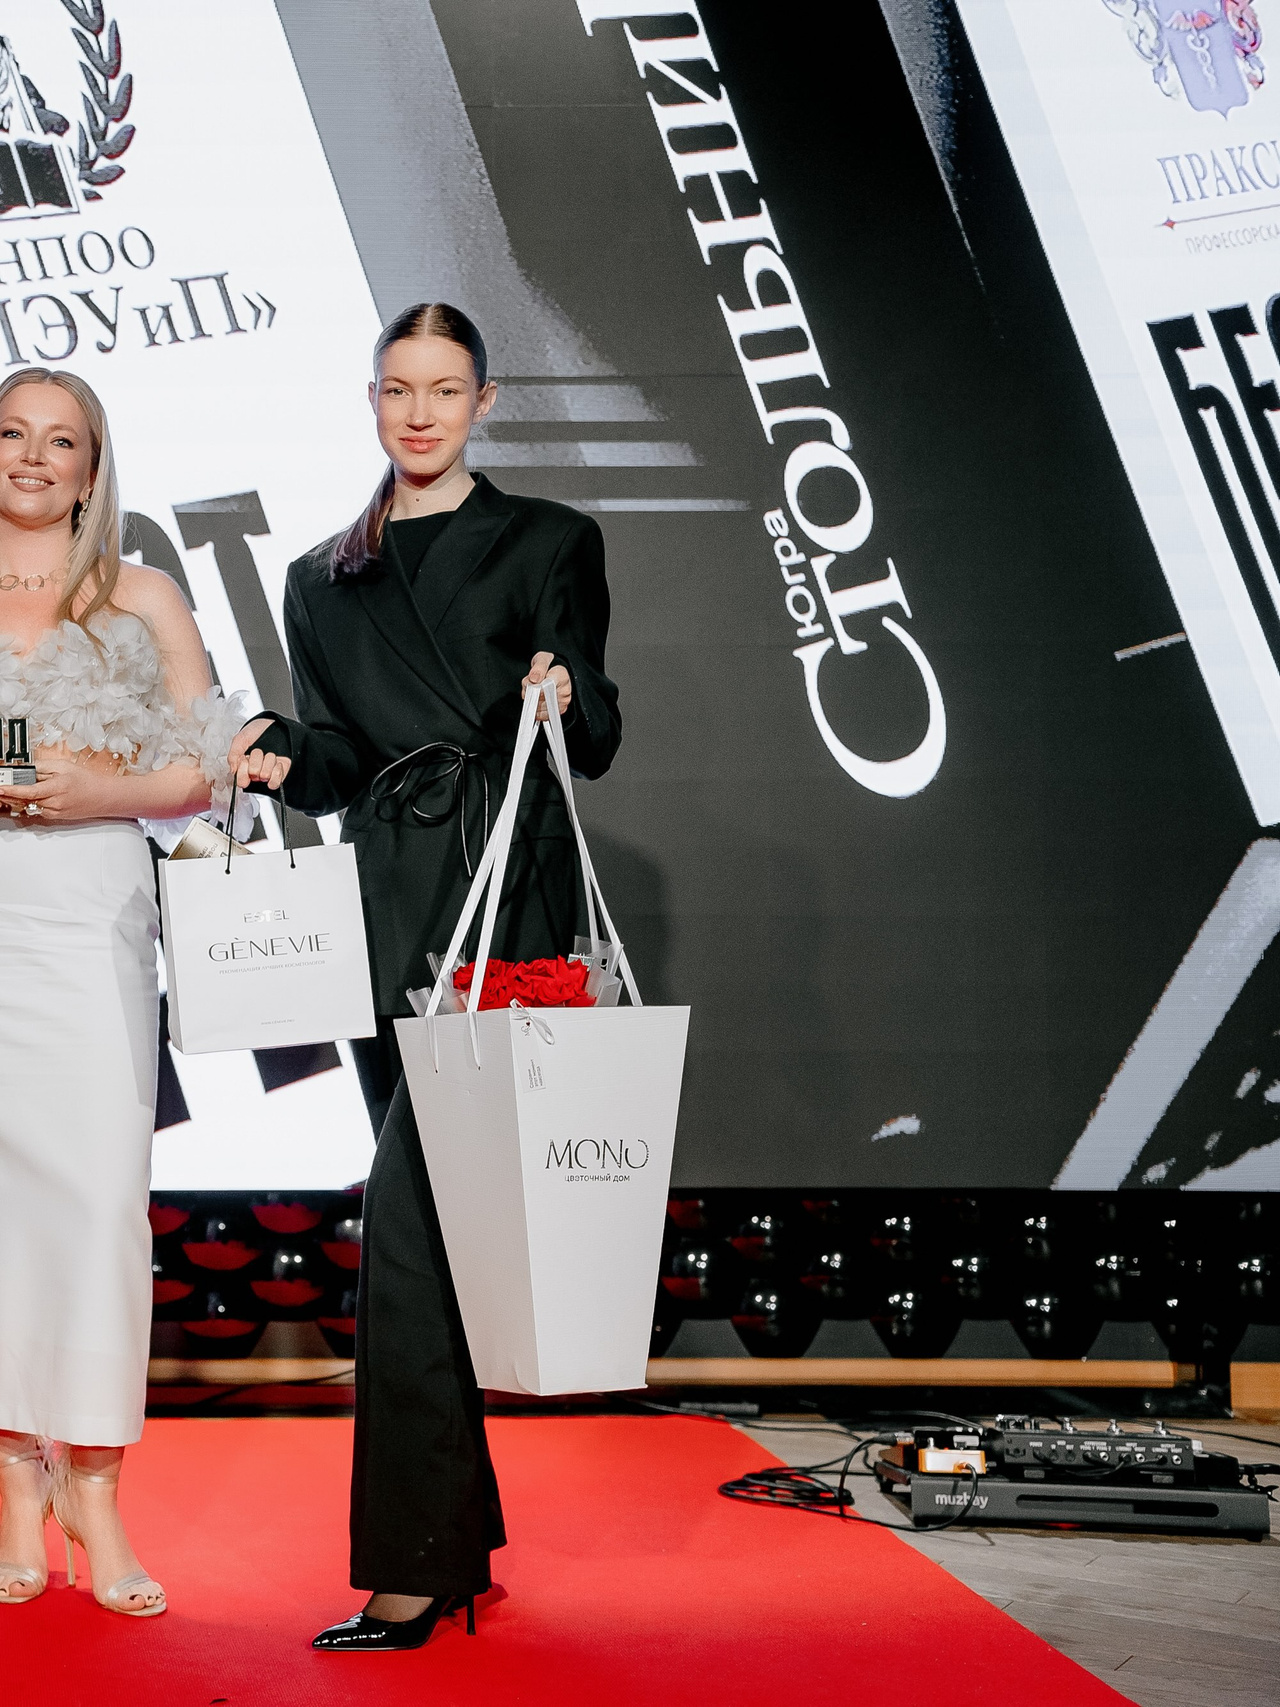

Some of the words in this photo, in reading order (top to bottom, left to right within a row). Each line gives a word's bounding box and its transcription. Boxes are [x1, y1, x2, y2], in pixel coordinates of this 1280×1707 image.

[763, 507, 825, 639] Югра
[243, 909, 290, 924] ESTEL
[208, 932, 333, 962] GÈNEVIE
[564, 1172, 612, 1182] цветочный
[612, 1174, 631, 1183] дом
